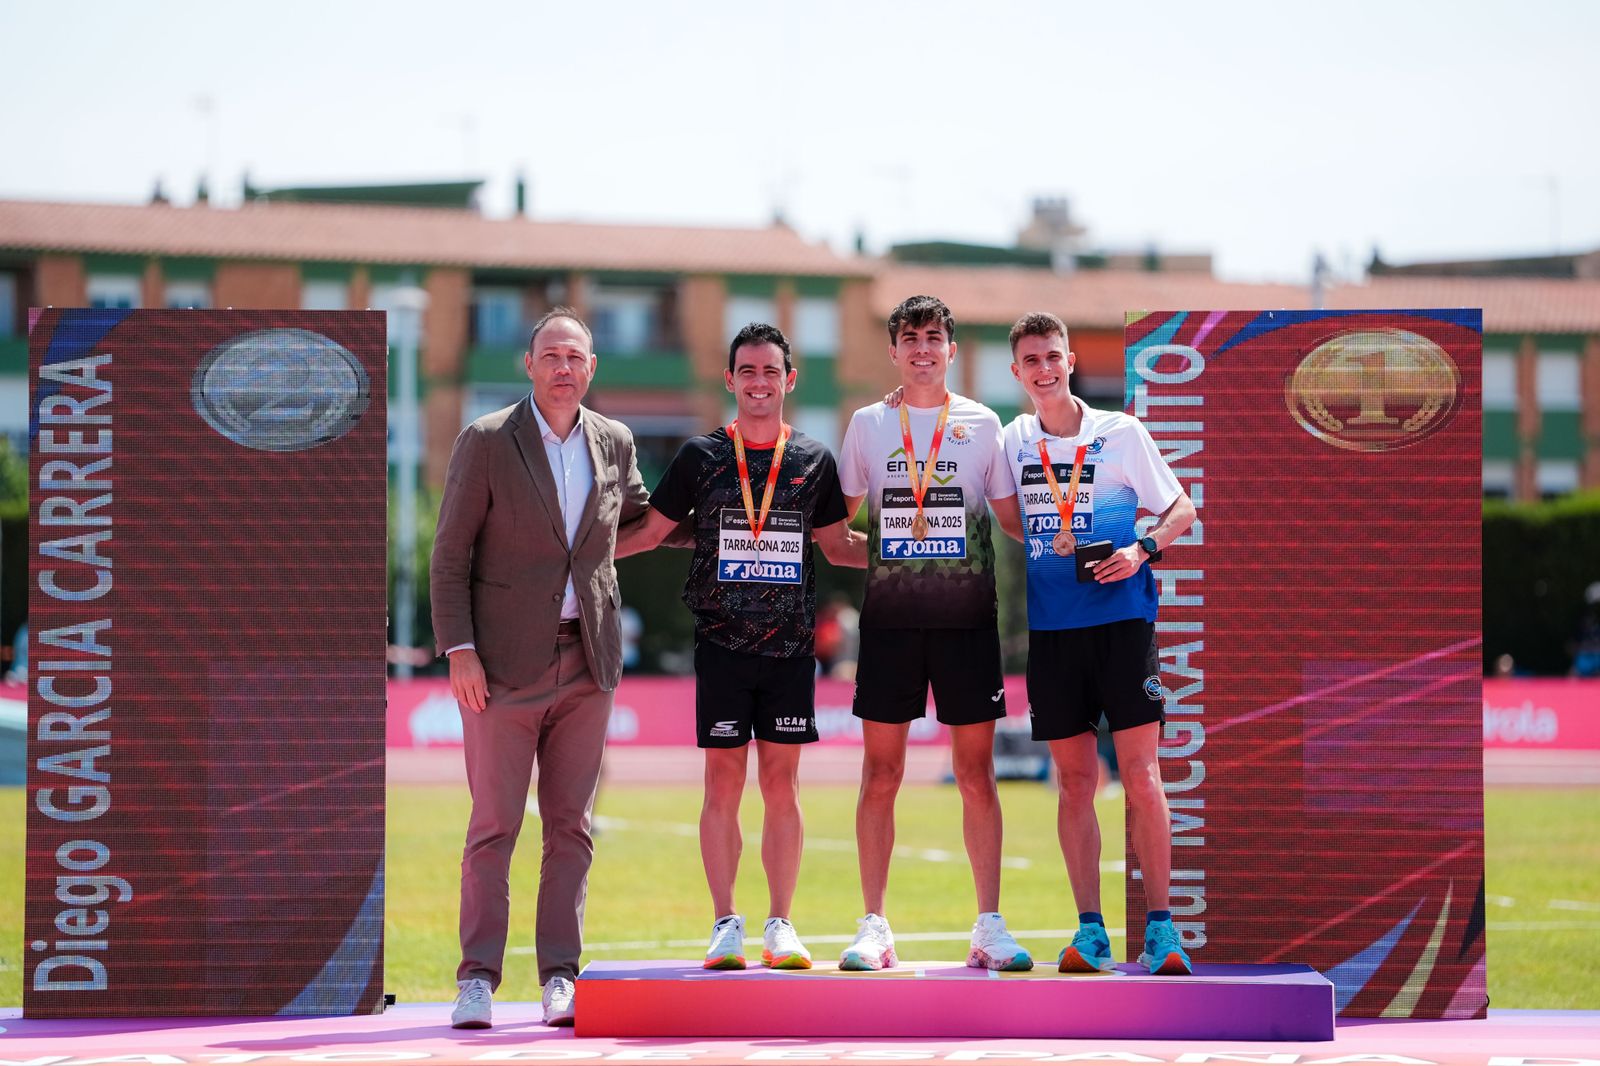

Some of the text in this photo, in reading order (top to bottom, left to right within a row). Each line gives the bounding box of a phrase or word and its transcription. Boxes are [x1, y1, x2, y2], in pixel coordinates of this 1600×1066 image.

[1133, 344, 1206, 545] BNITO
[1024, 492, 1067, 506] TARRAGOA
[884, 516, 962, 529] TARRANA 2025
[780, 540, 800, 554] 2025
[33, 353, 133, 992] Diego GARCIA CARRERA
[775, 717, 807, 727] UCAM
[468, 1049, 711, 1061] DE
[743, 1049, 1440, 1065] ESPAÑA
